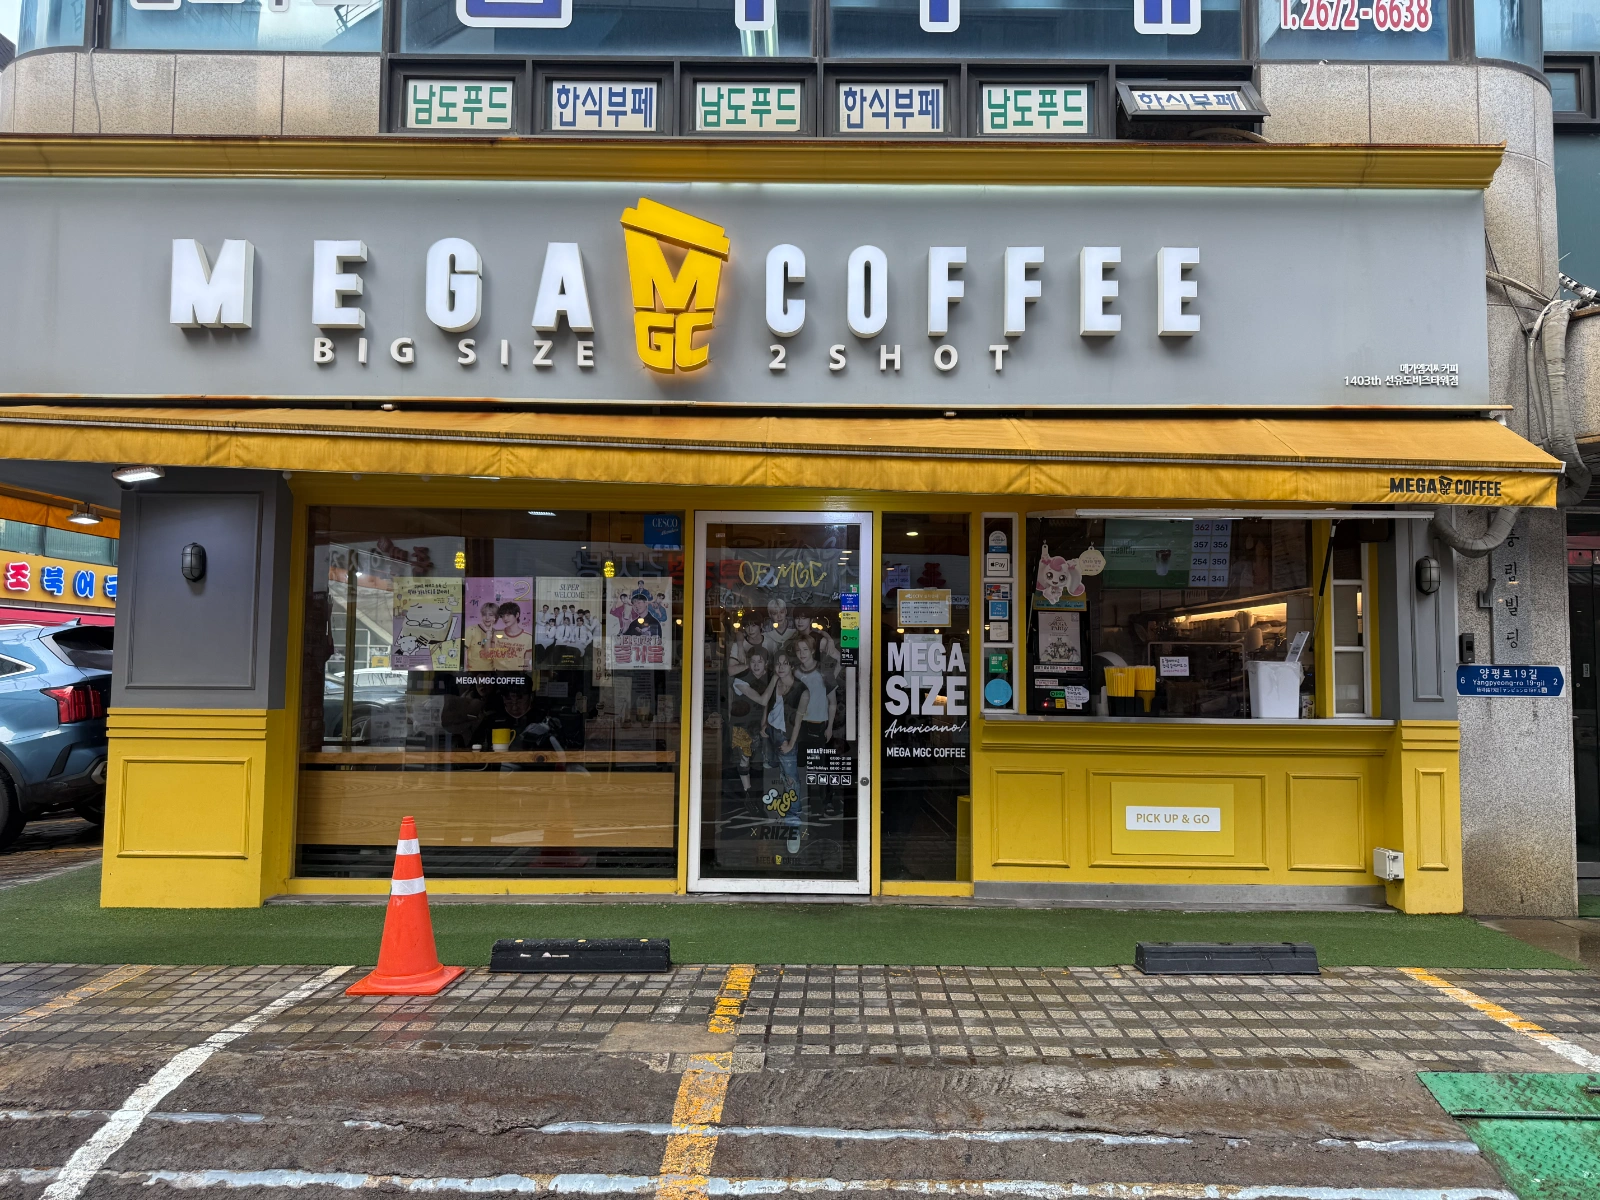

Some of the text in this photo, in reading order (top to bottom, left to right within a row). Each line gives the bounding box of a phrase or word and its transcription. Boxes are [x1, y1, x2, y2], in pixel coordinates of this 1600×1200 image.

[413, 84, 508, 125] 남도푸드
[556, 84, 653, 128] 한식부페
[701, 86, 797, 127] 남도푸드
[843, 86, 940, 129] 한식부페
[987, 88, 1084, 129] 남도푸드
[170, 237, 594, 333] MEGA
[765, 244, 1201, 338] COFFEE
[312, 336, 1010, 372] BIG SIZE 2 SHOT
[1441, 363, 1459, 374] 커피
[1344, 375, 1459, 387] 1403th 선유도비즈타워점
[1389, 477, 1437, 493] MEGA
[1455, 479, 1502, 497] COFFEE
[652, 517, 678, 528] CESCO
[1194, 523, 1228, 531] 362 361
[1213, 541, 1228, 549] 356
[1192, 558, 1227, 566] 254 350
[1211, 575, 1225, 583] 341
[559, 583, 580, 591] SUPER
[554, 591, 585, 599] WELCOME
[887, 642, 967, 672] MEGA
[496, 677, 525, 685] COFFEE
[1472, 678, 1524, 687] Yangpyeong-ro
[1553, 678, 1558, 686] 2
[884, 675, 968, 716] SIZE
[884, 718, 967, 740] Americano!
[886, 747, 966, 758] MEGA MGC COFFEE
[1136, 813, 1210, 824] PICK UP & GO
[759, 826, 800, 841] RIIZE
